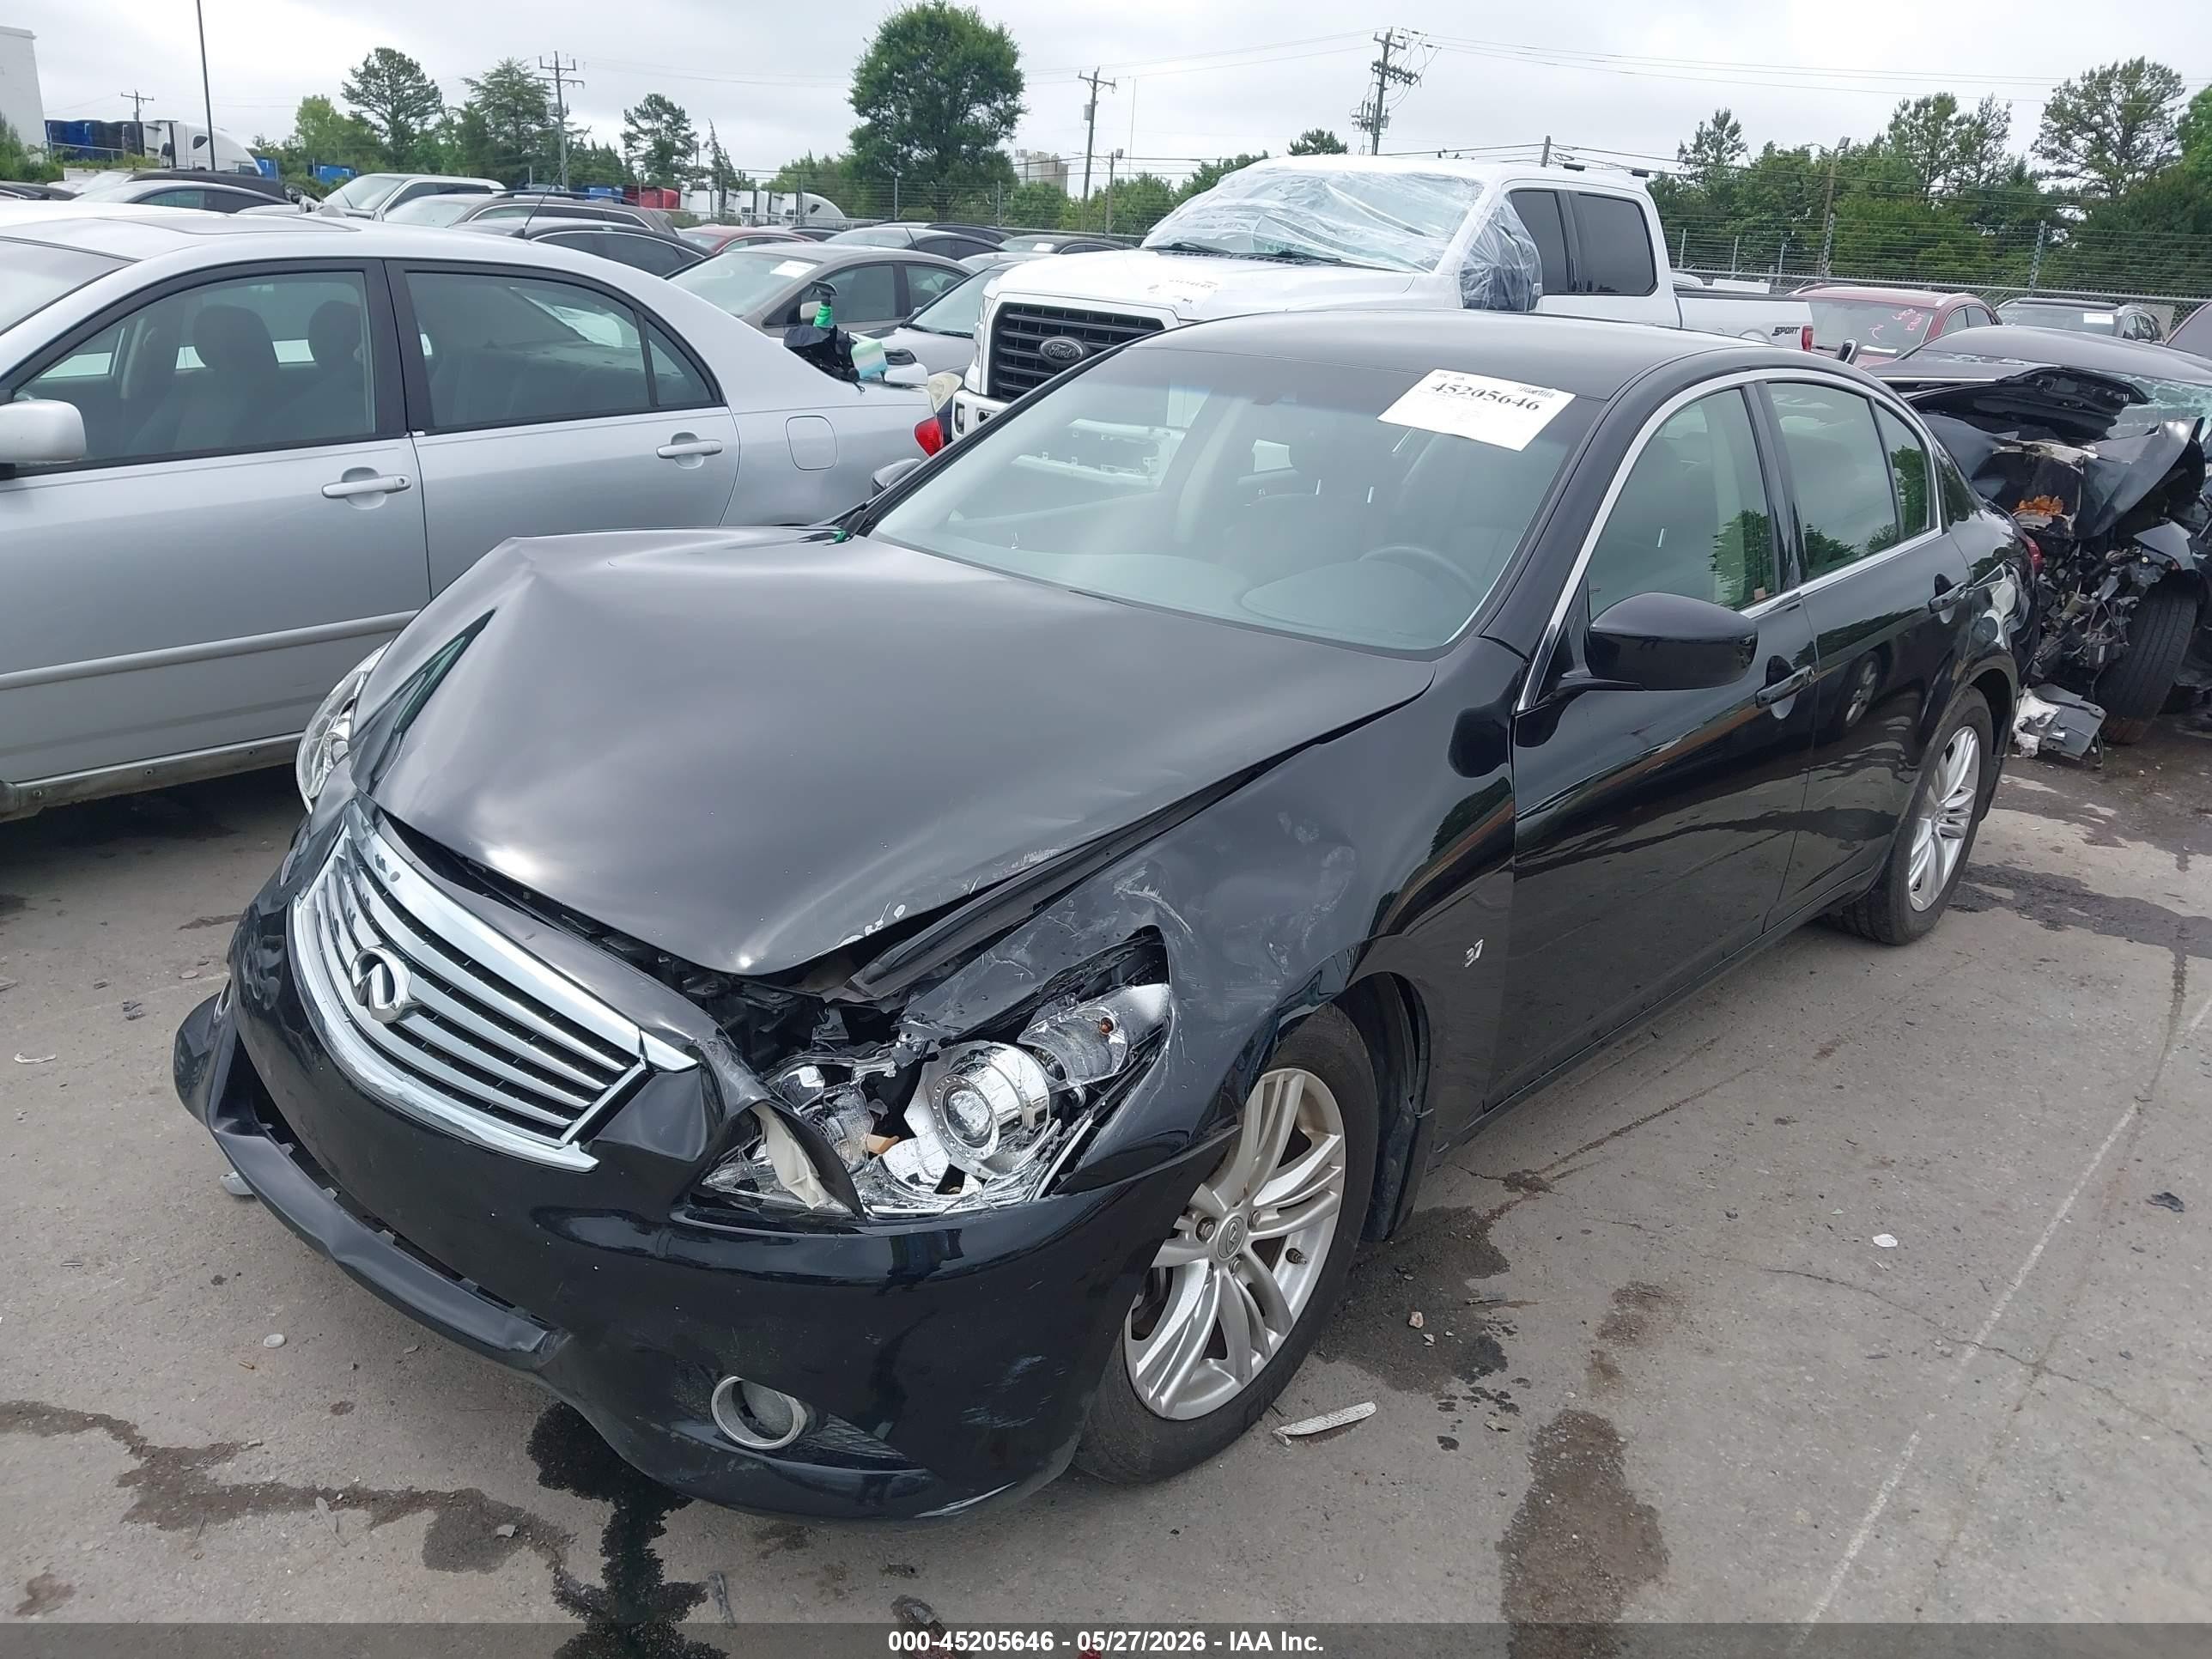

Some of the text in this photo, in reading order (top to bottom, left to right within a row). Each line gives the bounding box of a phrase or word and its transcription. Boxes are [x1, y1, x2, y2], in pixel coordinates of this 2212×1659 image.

[1771, 326, 1800, 337] SPORT
[1048, 343, 1072, 358] Ford
[1431, 382, 1540, 410] 45205646
